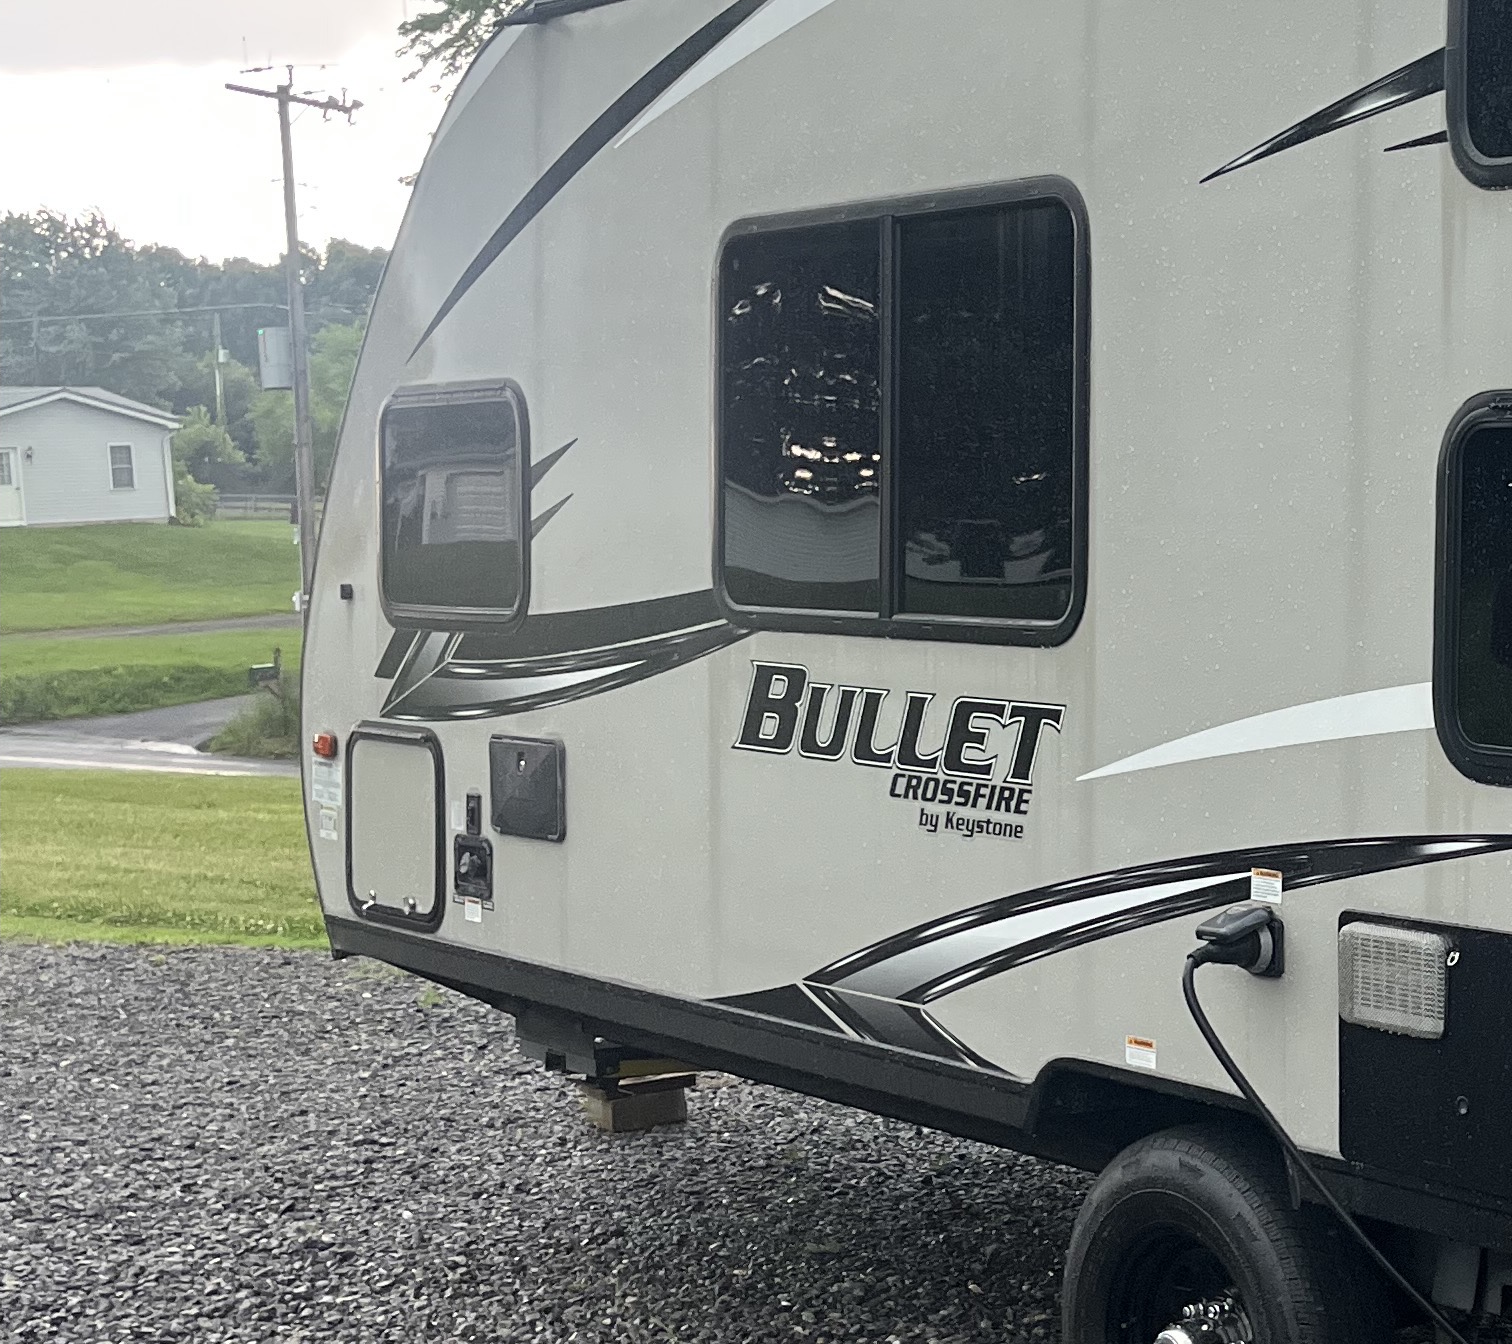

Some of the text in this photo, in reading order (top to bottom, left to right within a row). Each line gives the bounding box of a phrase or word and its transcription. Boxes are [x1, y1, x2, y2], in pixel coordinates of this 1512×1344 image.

[731, 659, 1067, 785] BULLET
[889, 772, 1033, 815] CROSSFIRE
[918, 807, 1024, 839] by Keystone
